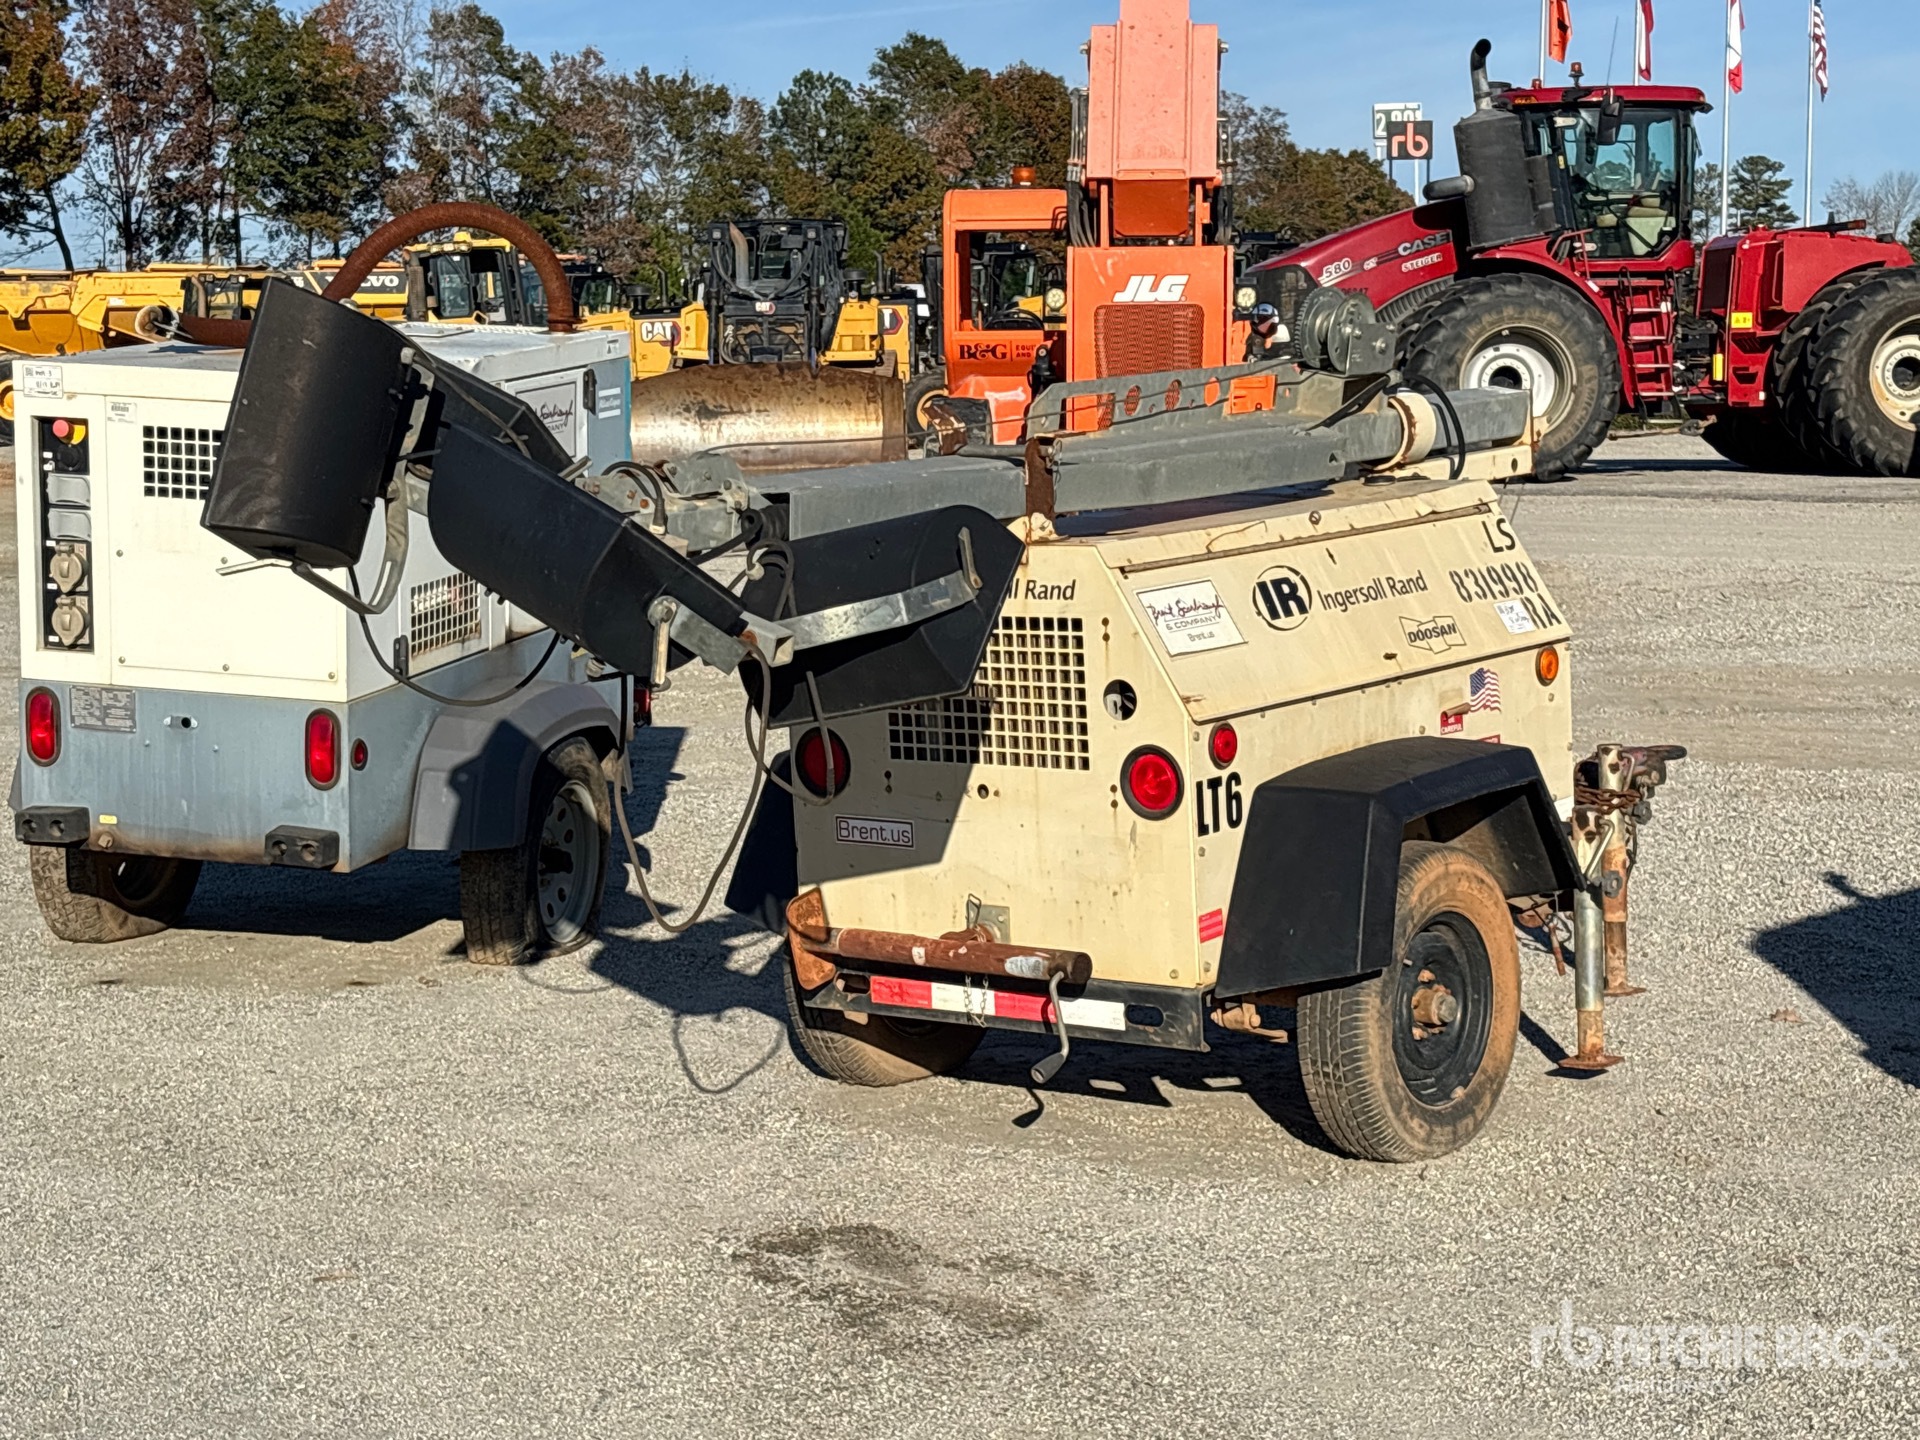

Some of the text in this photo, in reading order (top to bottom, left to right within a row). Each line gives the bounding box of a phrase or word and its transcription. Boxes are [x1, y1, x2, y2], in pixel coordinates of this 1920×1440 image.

[1391, 122, 1429, 158] rb
[1398, 231, 1449, 257] CASE
[1322, 258, 1351, 279] 580
[1402, 253, 1443, 272] STEIGER
[1112, 274, 1190, 303] JLG
[641, 321, 674, 343] CAT
[959, 343, 1008, 361] B&G
[1481, 518, 1516, 553] LS
[1025, 579, 1076, 600] Rand
[1317, 569, 1429, 613] Ingersoll Rand
[1449, 562, 1538, 603] 831998
[1256, 577, 1309, 621] IR
[1174, 615, 1217, 629] COMPANY
[1407, 623, 1458, 643] DOOSAN
[1196, 771, 1243, 838] LT6
[839, 820, 911, 844] Brent.us
